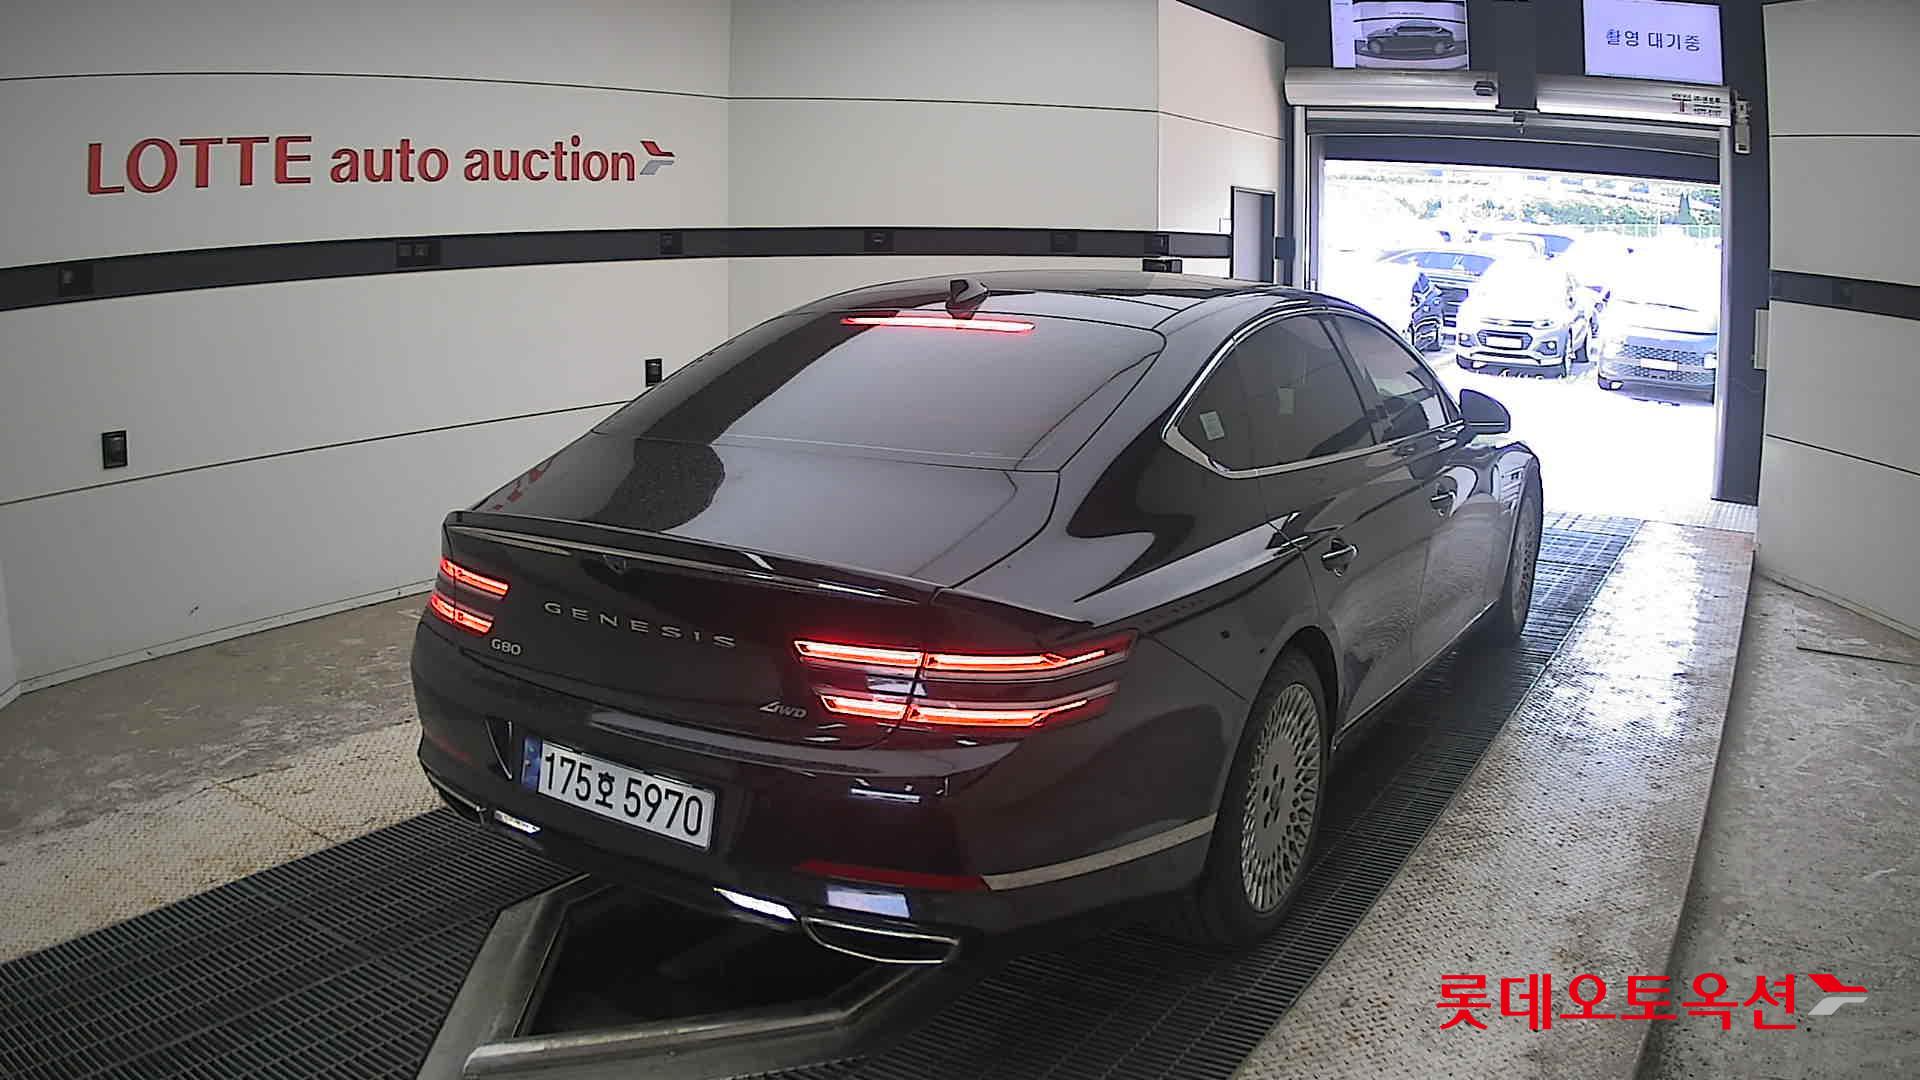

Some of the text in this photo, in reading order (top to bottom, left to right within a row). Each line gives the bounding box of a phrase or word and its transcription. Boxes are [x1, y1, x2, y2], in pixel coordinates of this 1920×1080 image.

[1606, 28, 1700, 52] 촬영 대기중
[87, 135, 636, 194] LOTTE auto auction
[544, 602, 737, 649] GENESIS
[491, 638, 521, 657] G80
[760, 700, 808, 719] 4WD
